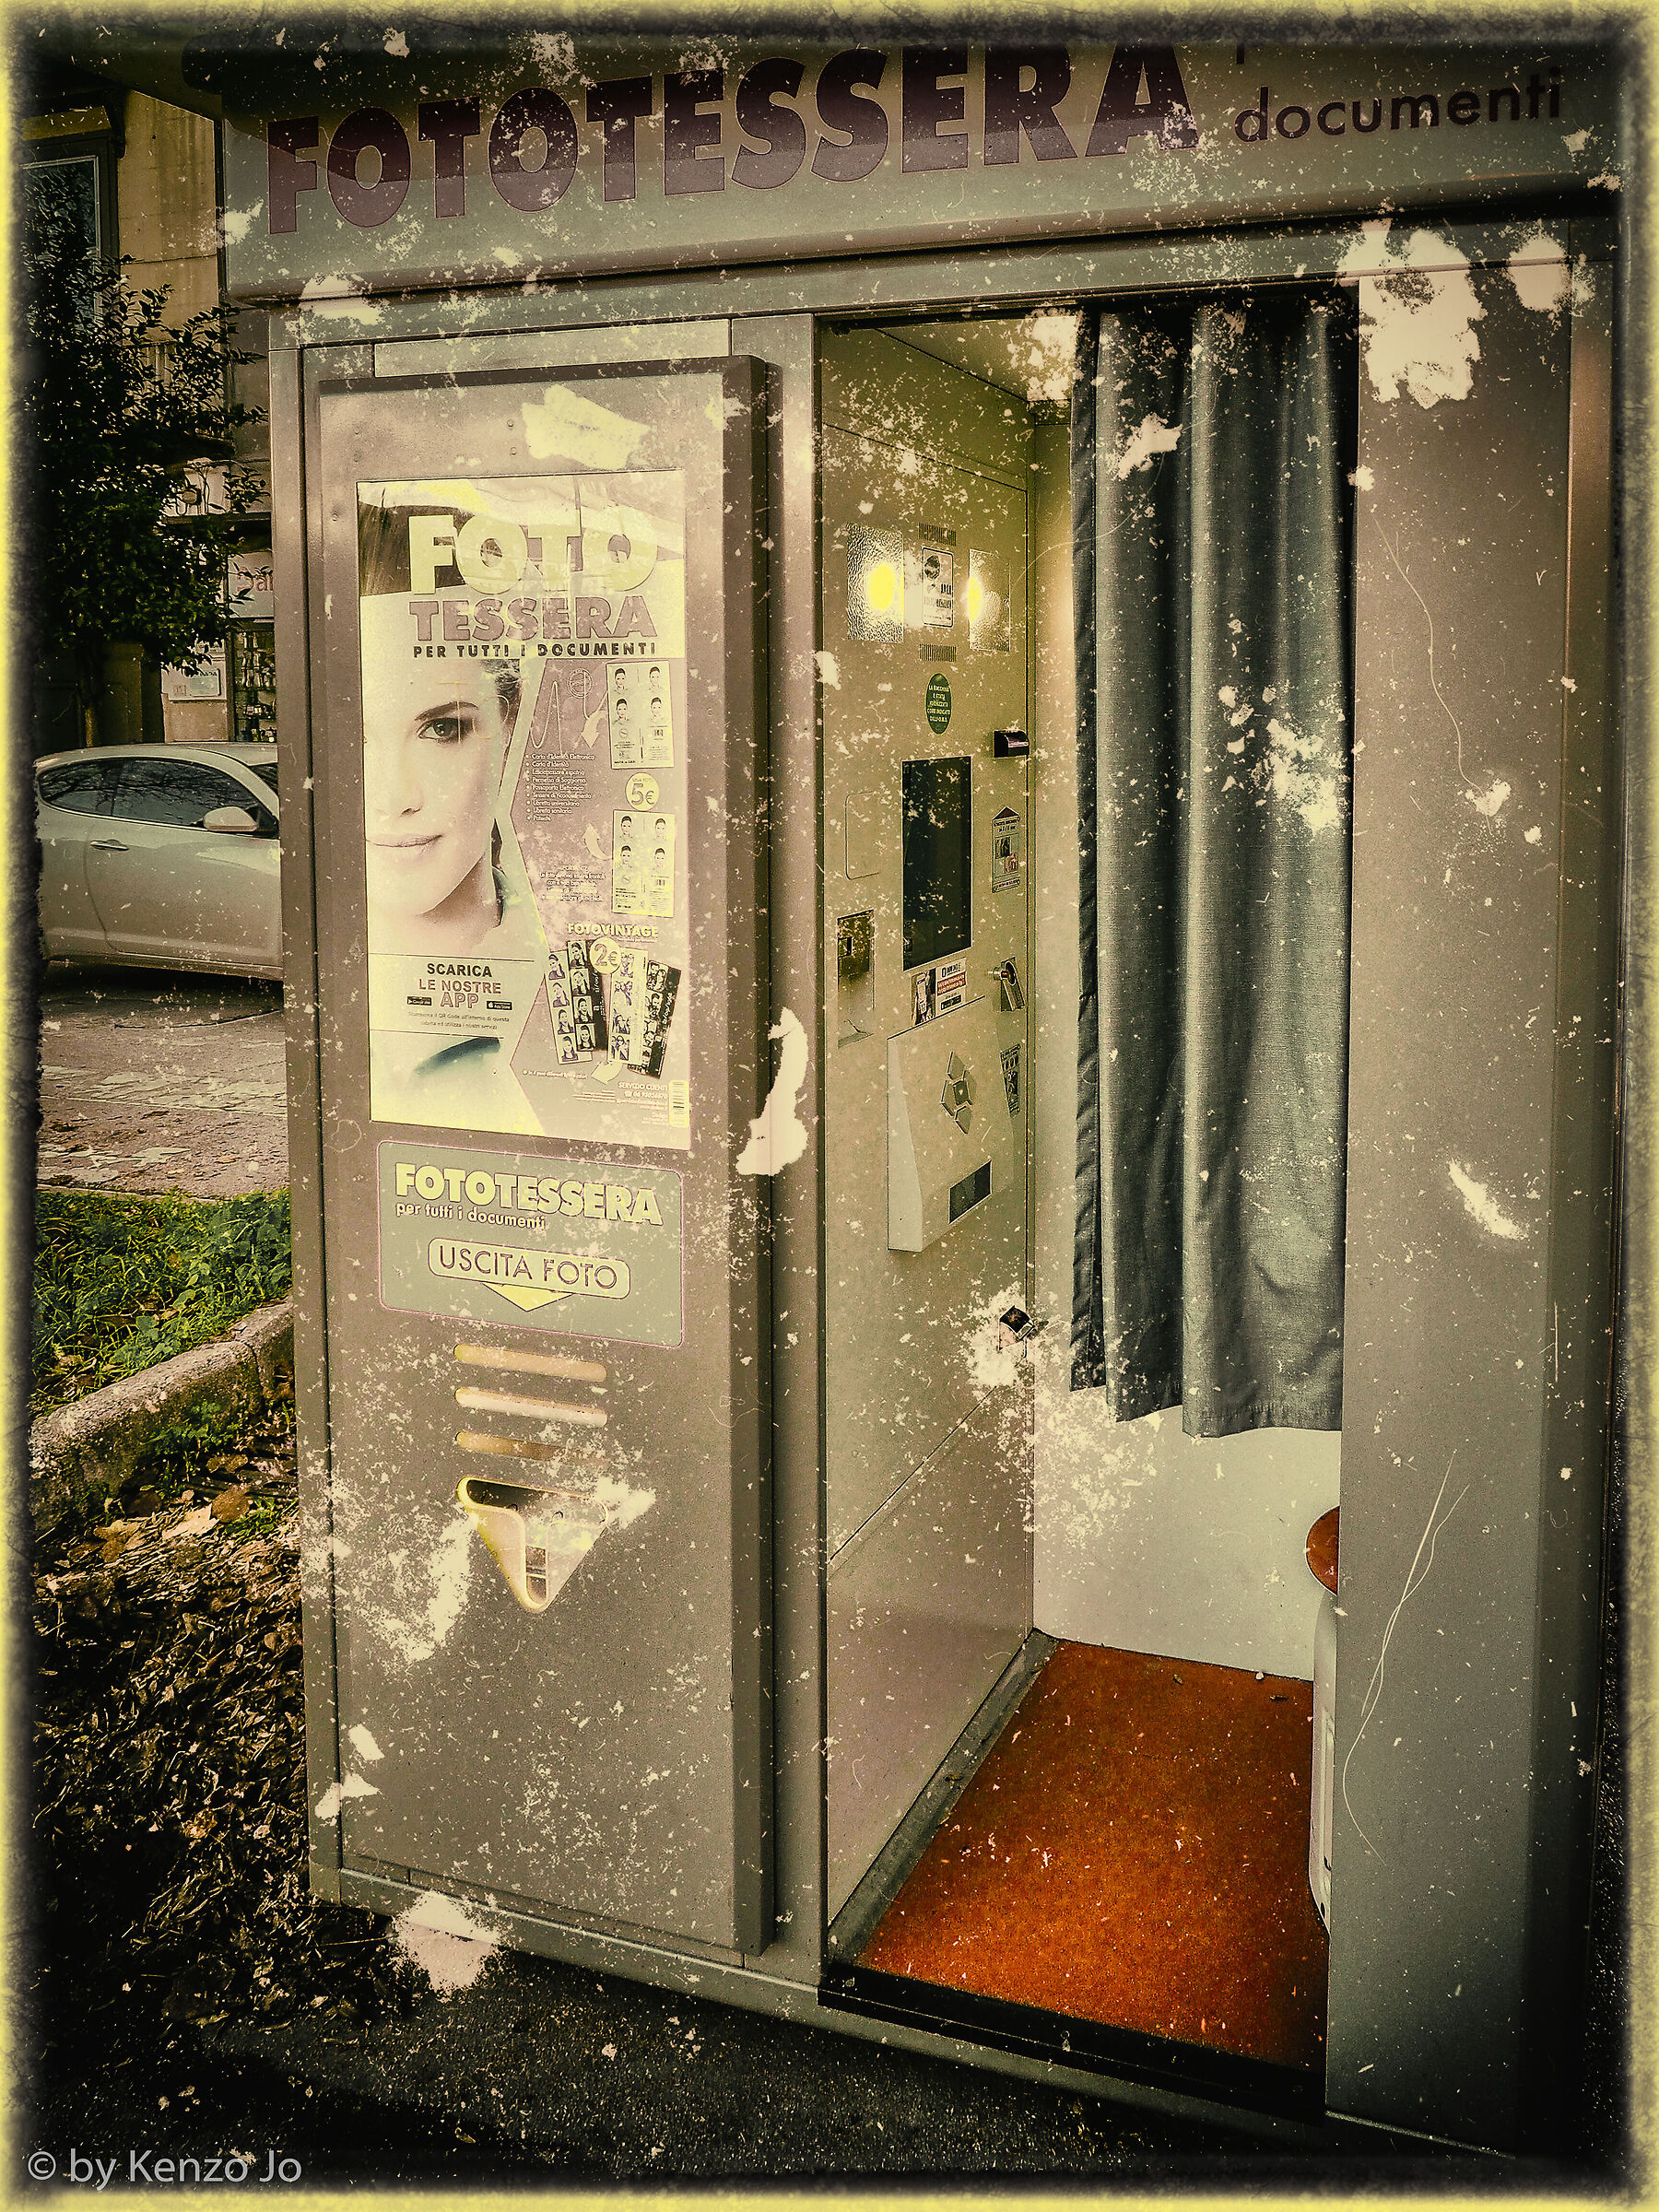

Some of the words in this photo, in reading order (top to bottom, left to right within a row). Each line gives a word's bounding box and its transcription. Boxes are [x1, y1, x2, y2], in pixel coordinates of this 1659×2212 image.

[1235, 66, 1563, 142] documenti
[267, 40, 1199, 234] FOTOTESSERA
[408, 513, 658, 595] FOTO
[408, 595, 658, 641] TESSERA
[414, 645, 446, 658] PER
[456, 643, 509, 658] TUTTI
[521, 643, 526, 657] I
[537, 641, 656, 657] DOCUMENTI
[631, 782, 654, 806] 5€
[567, 922, 658, 938] FOTOVINTAGE
[594, 943, 618, 966] 2€
[427, 962, 493, 978] SCARICA
[418, 979, 436, 991] LE
[441, 980, 501, 994] NOSTRE
[441, 992, 479, 1009] APP
[395, 1162, 664, 1226] FOTOTESSERA
[395, 1203, 421, 1218] per
[425, 1202, 453, 1219] tutti
[458, 1206, 463, 1220] i
[467, 1206, 546, 1230] documenti
[439, 1244, 534, 1280] USCITA
[543, 1258, 618, 1289] FOTO
